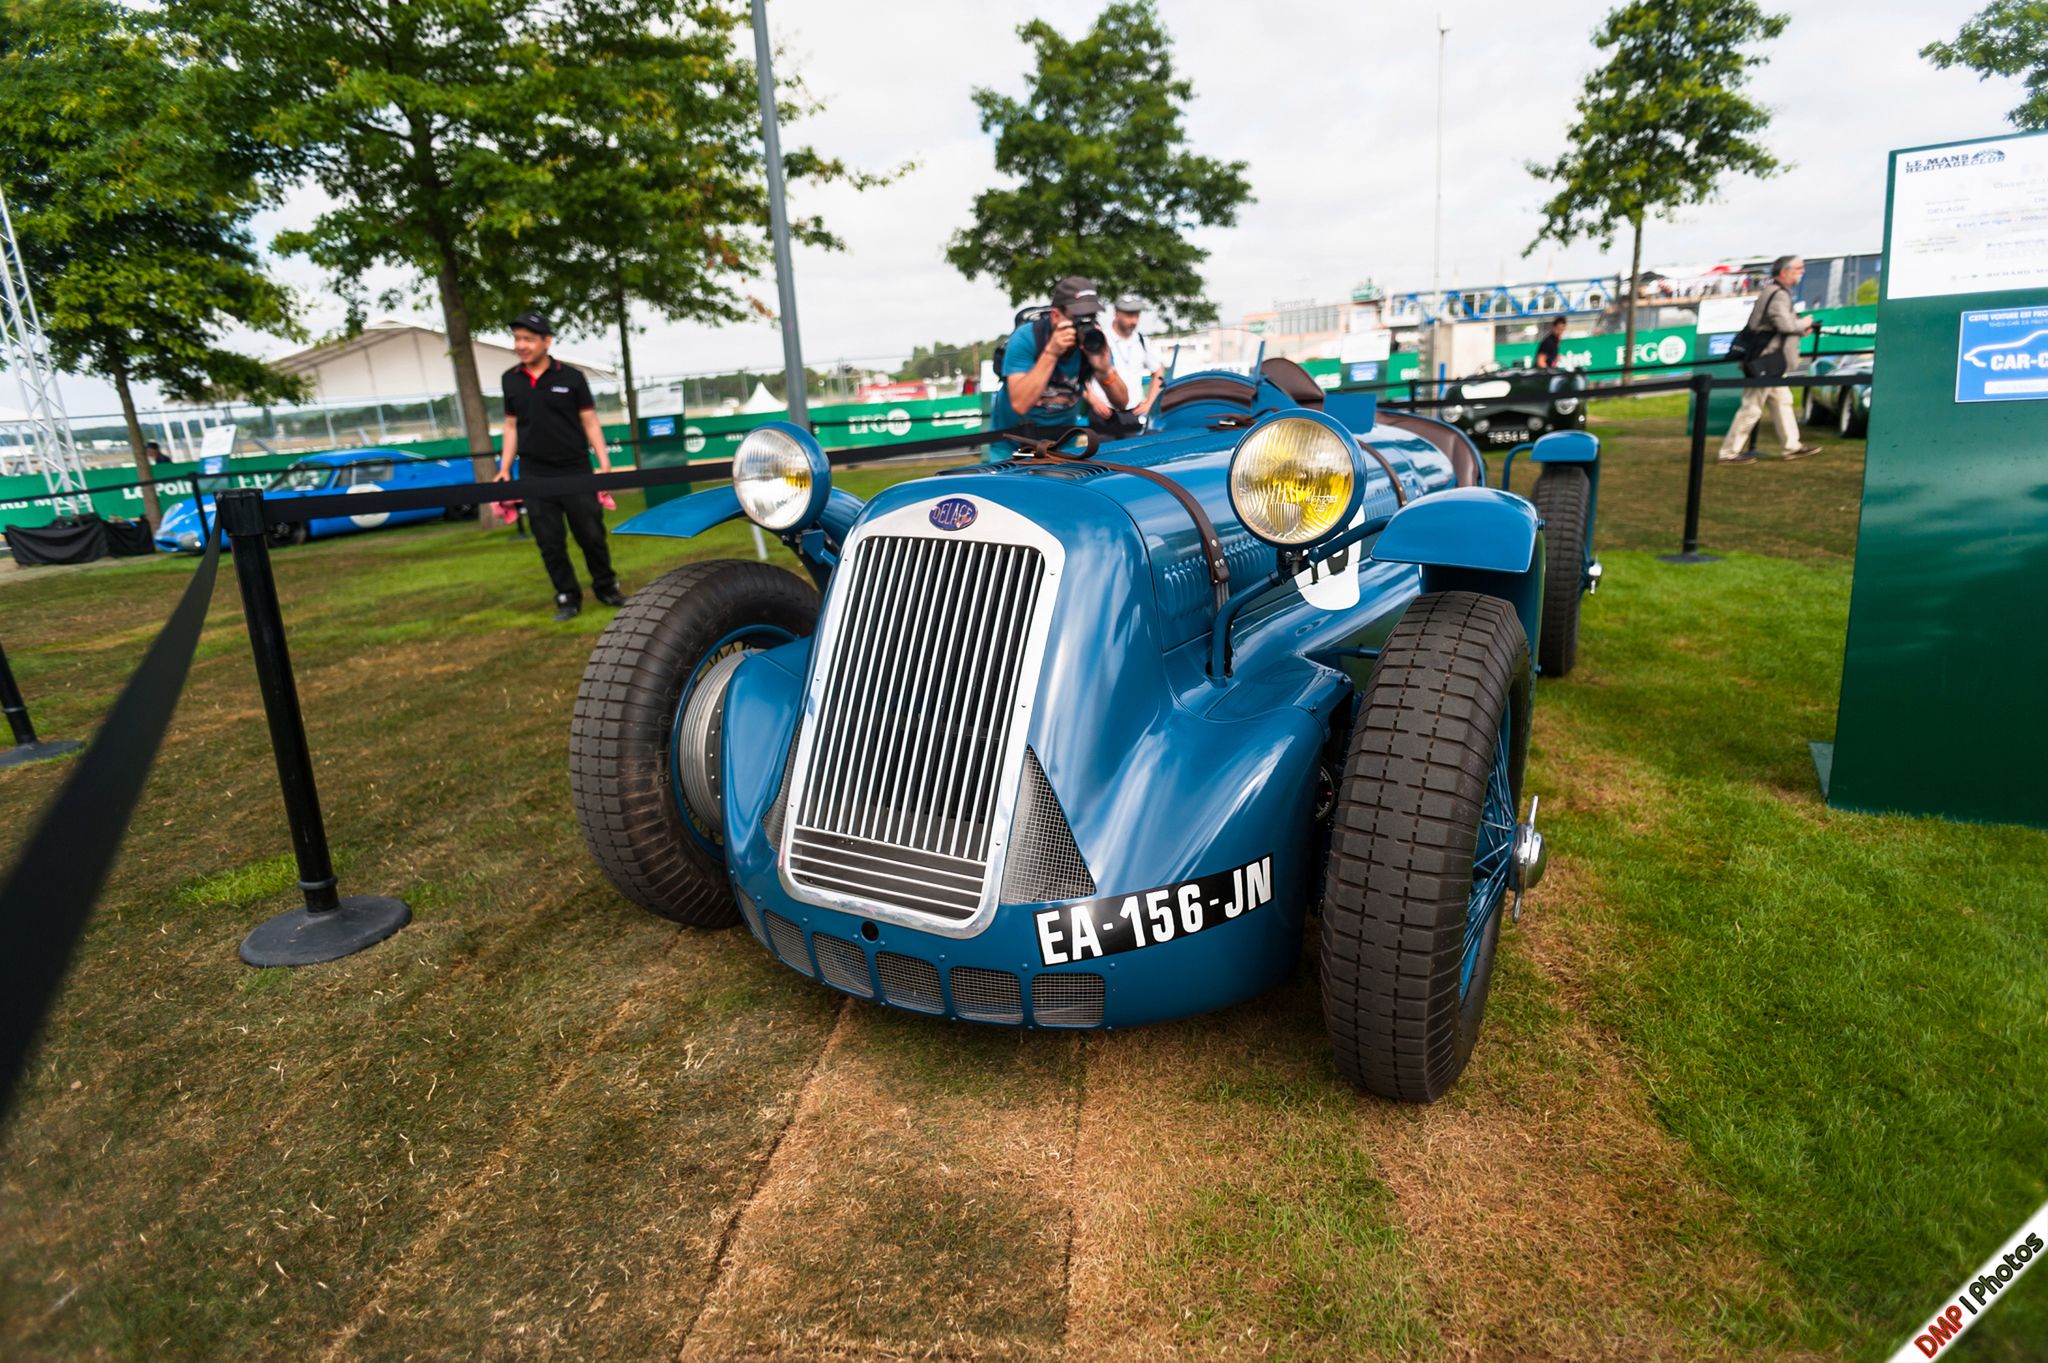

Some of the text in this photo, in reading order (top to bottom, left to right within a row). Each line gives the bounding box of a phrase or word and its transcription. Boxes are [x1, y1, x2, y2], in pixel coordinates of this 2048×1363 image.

[1906, 153, 1969, 169] LE MANS
[155, 479, 194, 498] Poin
[932, 502, 973, 526] DELAGE
[1037, 856, 1272, 965] EA-156-JN
